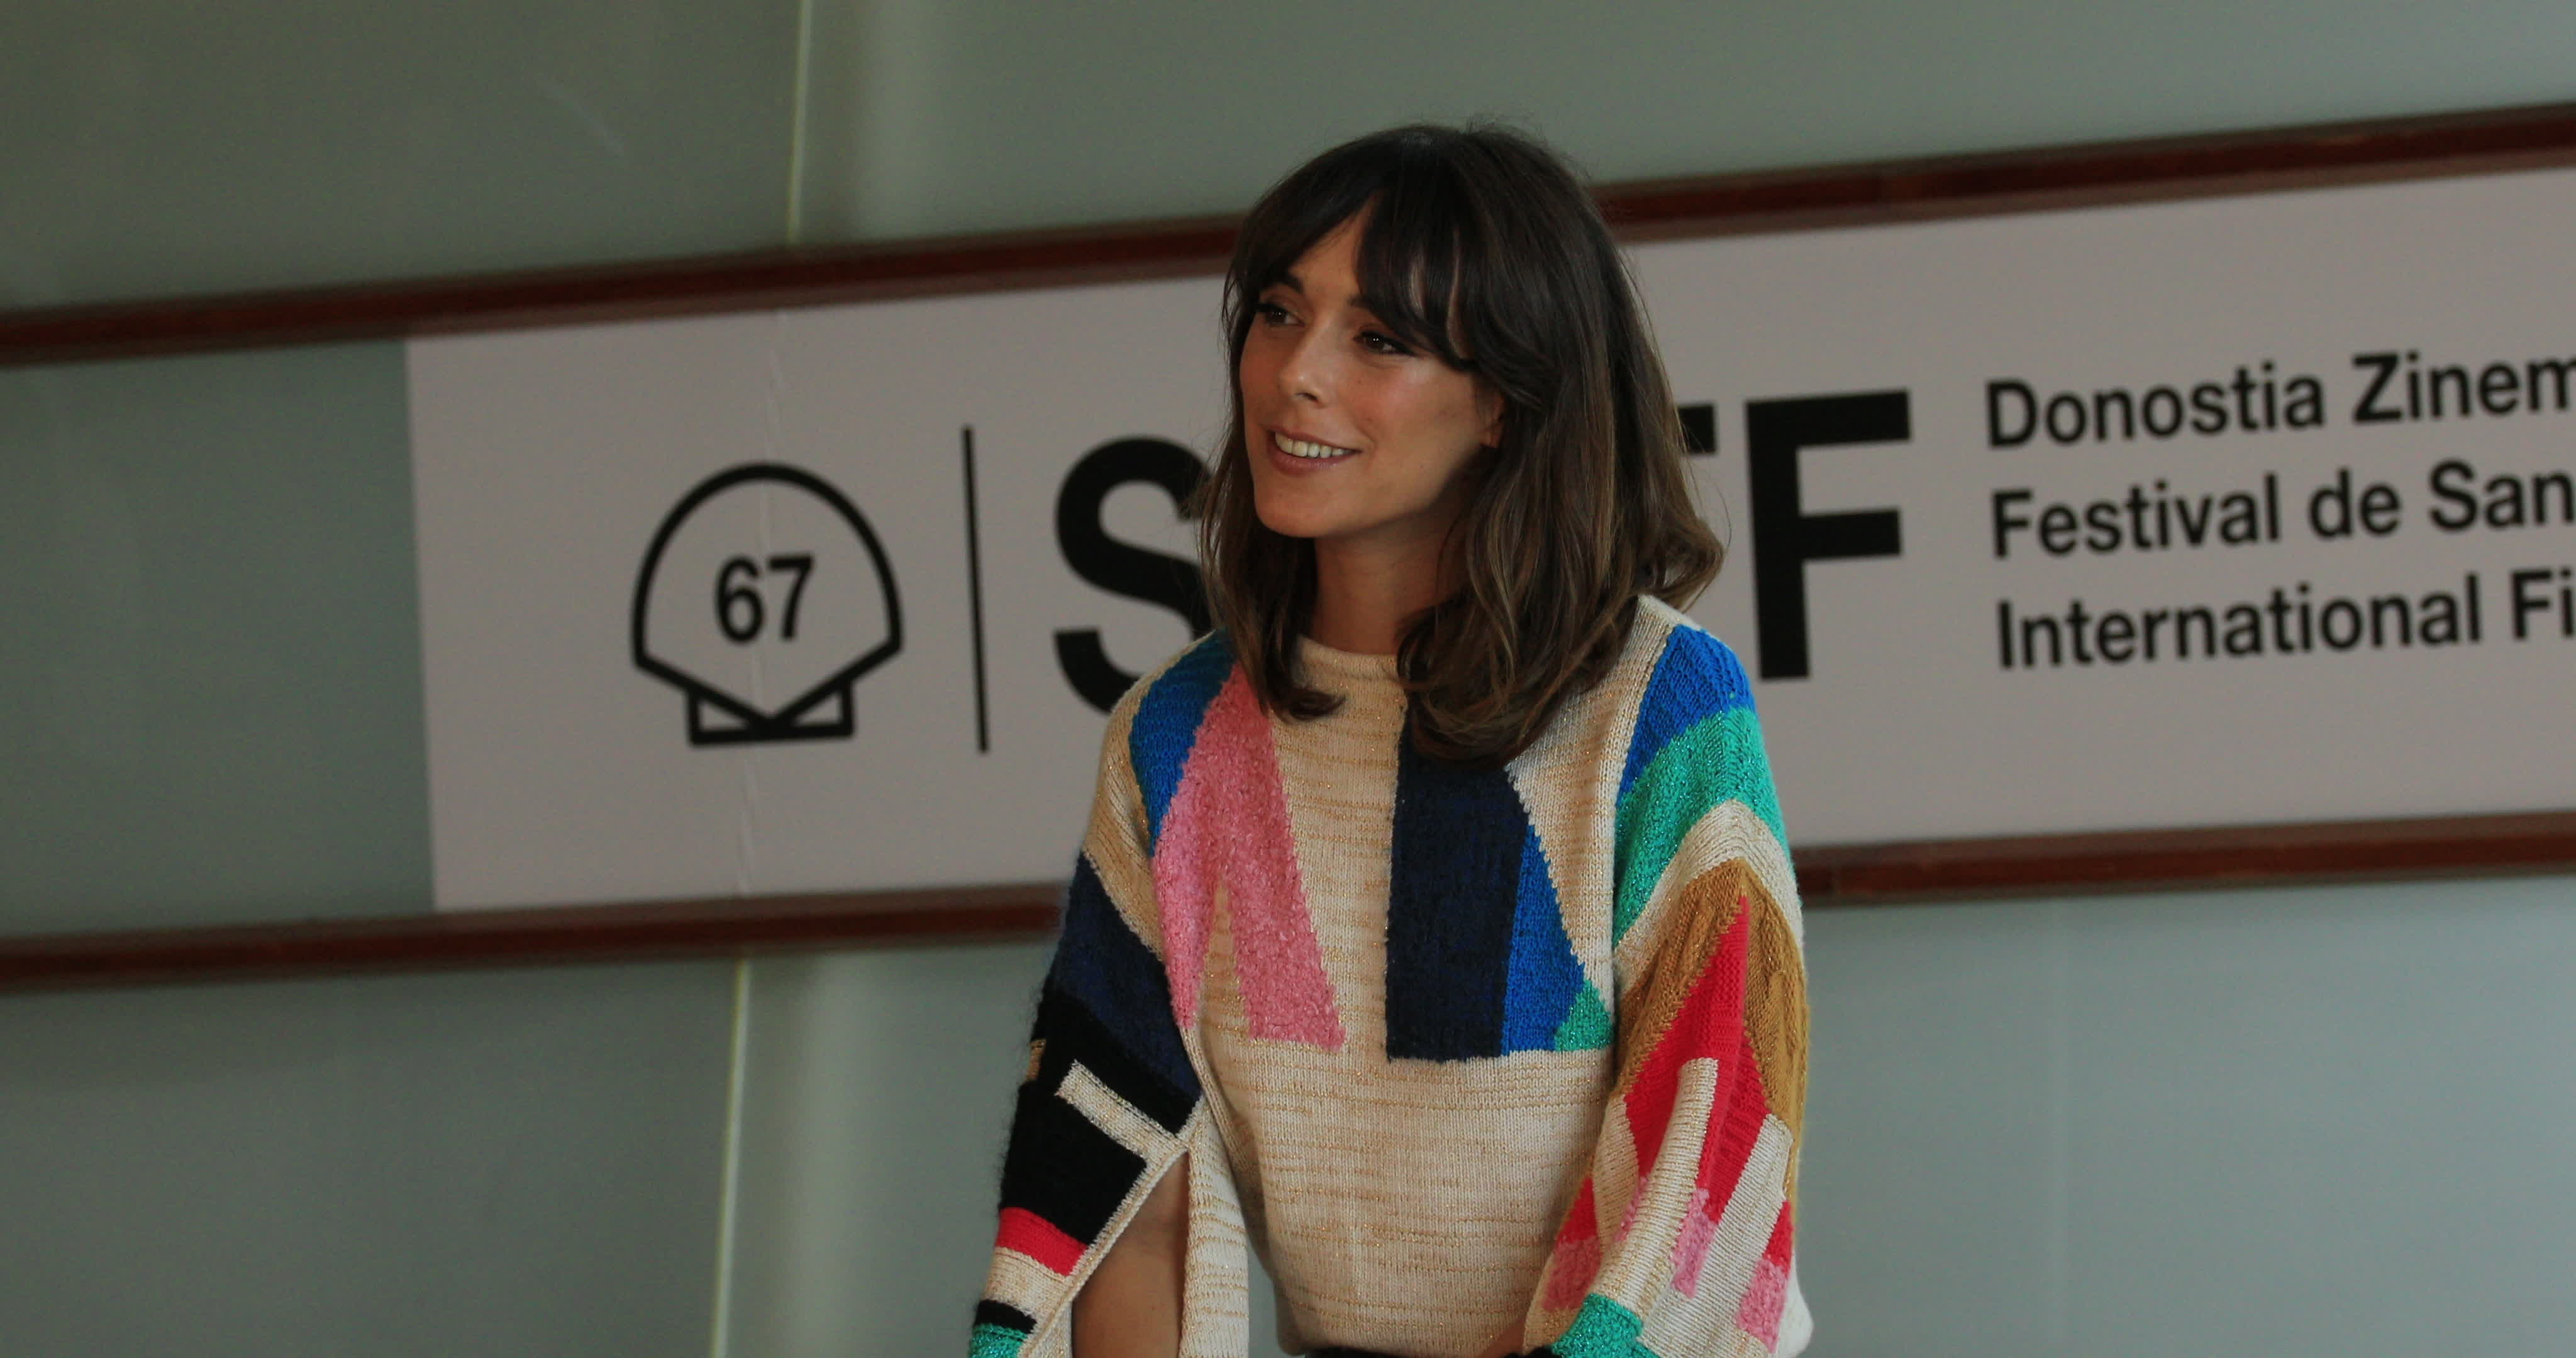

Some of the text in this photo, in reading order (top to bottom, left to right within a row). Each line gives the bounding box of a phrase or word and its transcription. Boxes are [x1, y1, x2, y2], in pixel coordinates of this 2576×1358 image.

[1986, 361, 2324, 449] Donostia
[1992, 460, 2575, 559] Festival de San
[713, 552, 815, 645] 67
[1997, 567, 2575, 669] International Fi
